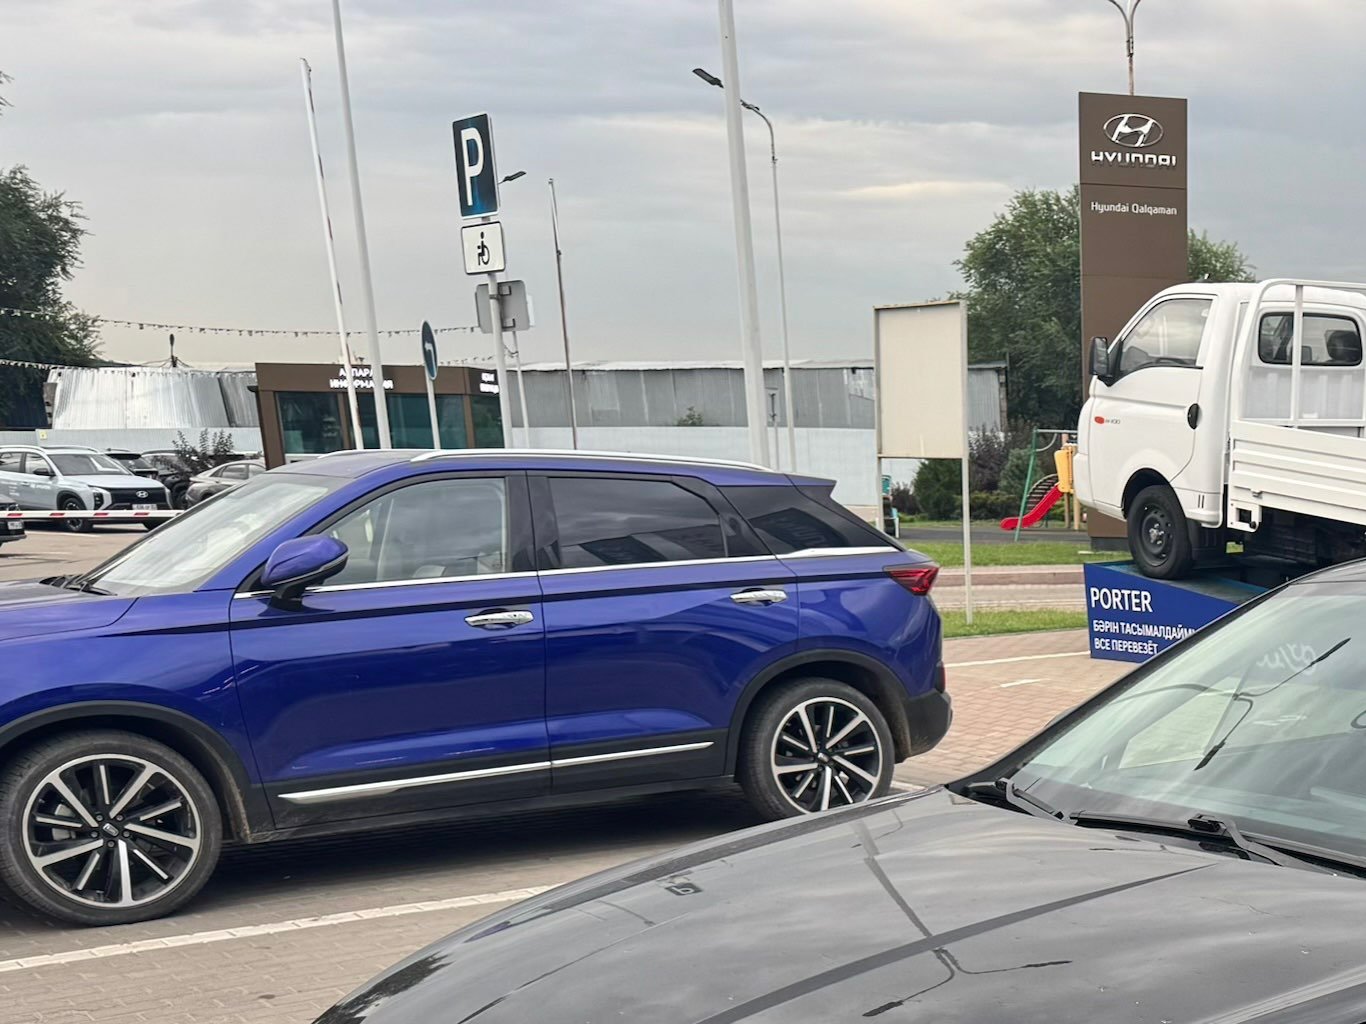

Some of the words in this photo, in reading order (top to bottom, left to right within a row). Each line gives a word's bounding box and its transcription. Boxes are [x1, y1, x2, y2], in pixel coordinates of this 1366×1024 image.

[461, 127, 484, 206] P
[1091, 151, 1176, 166] HYUNDAI
[1091, 201, 1130, 213] Hyundai
[1131, 203, 1177, 216] Qalqaman
[1090, 587, 1153, 612] PORTER
[1095, 638, 1111, 650] ВСЕ
[1112, 639, 1158, 655] ПЕРЕВЕЗЁТ
